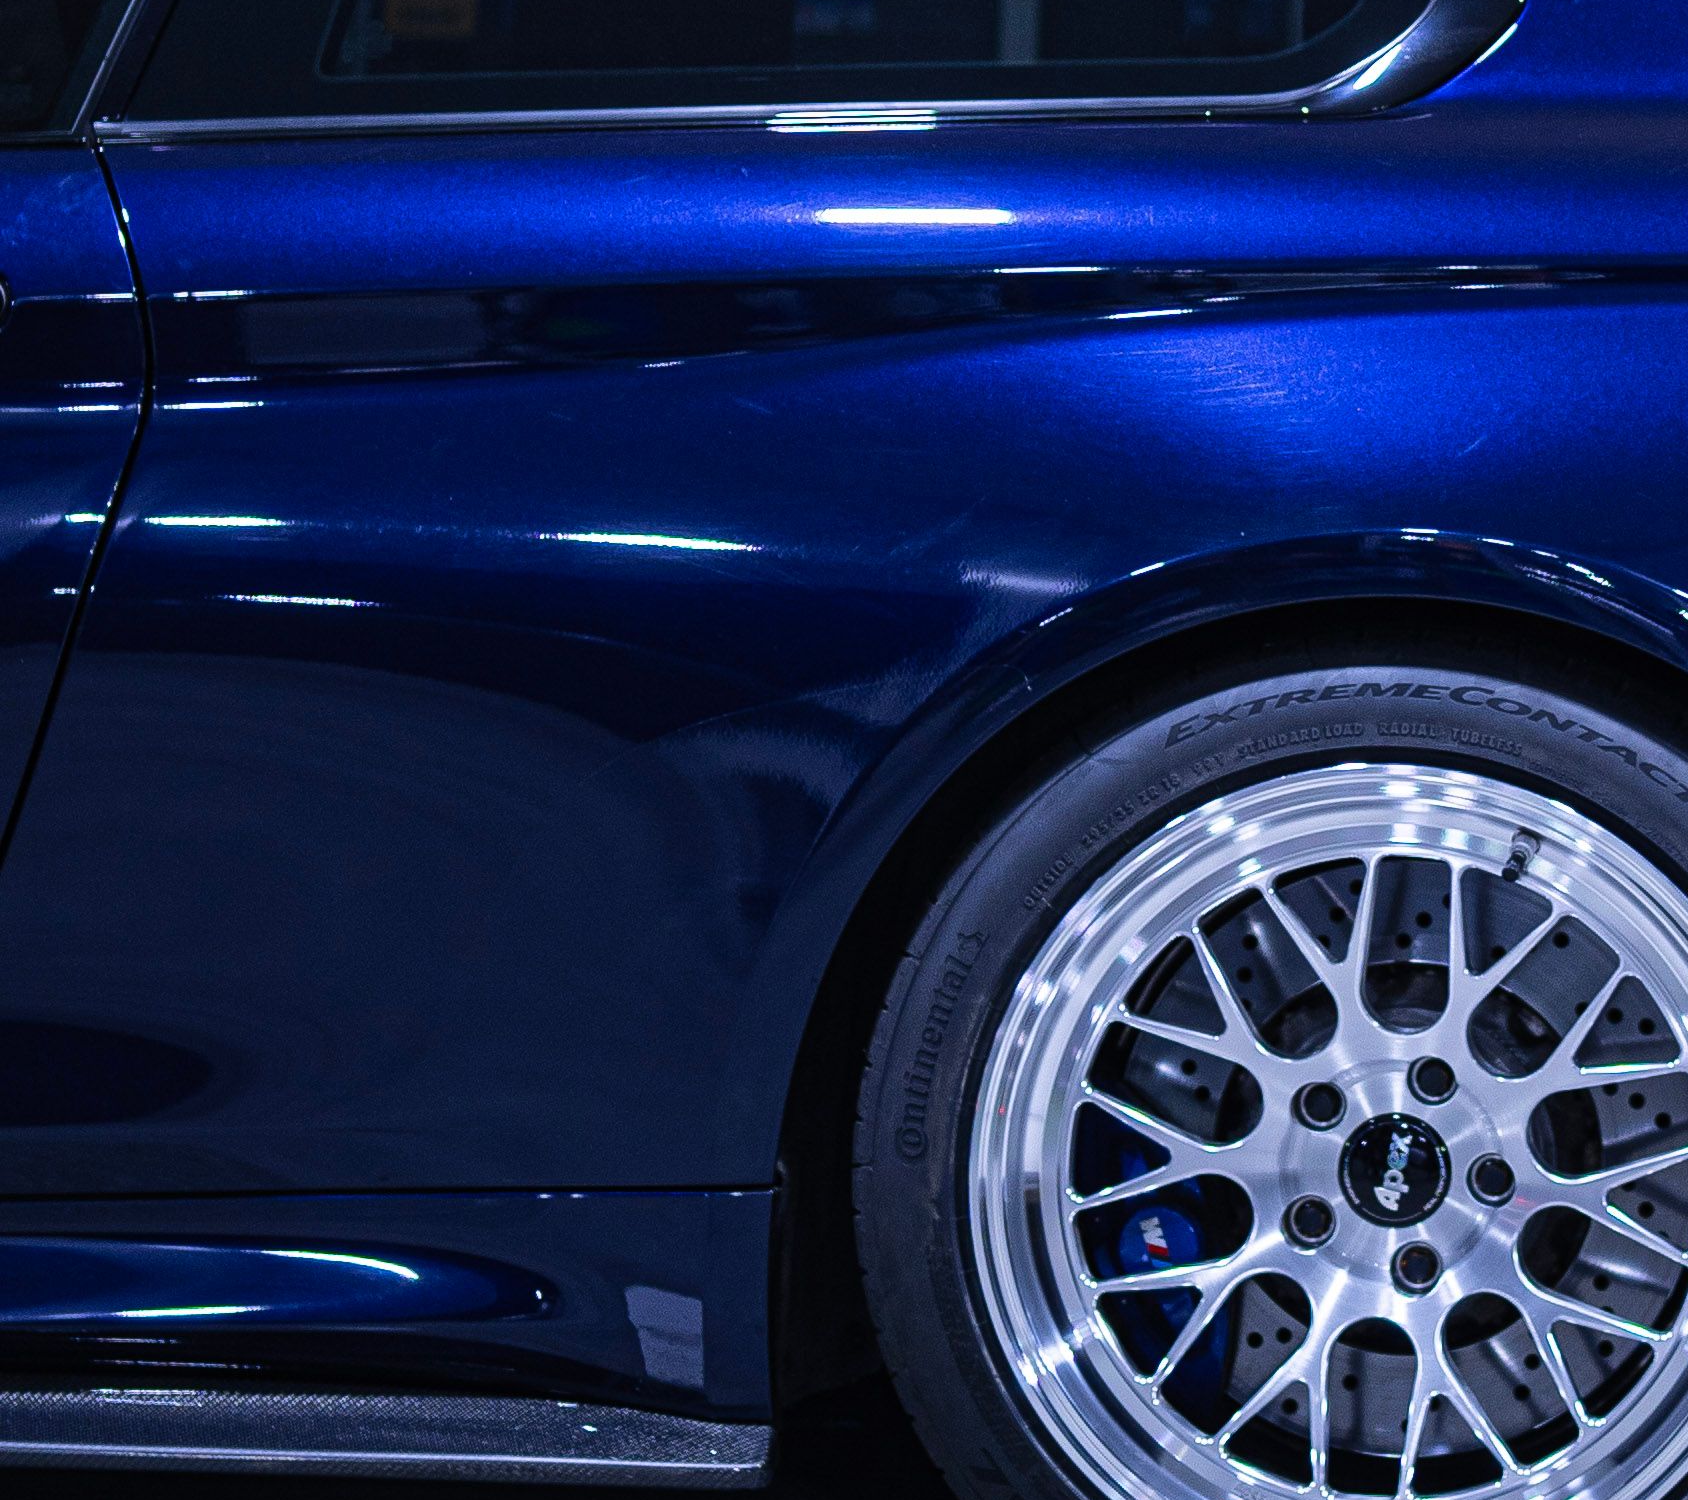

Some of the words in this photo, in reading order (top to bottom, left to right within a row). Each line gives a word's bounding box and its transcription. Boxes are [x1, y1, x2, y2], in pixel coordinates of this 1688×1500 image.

[1022, 852, 1074, 909] OUTSIDE
[1237, 728, 1320, 760] STANDARD
[1323, 722, 1363, 740] LOAD
[1377, 721, 1437, 738] RADIAL
[1450, 726, 1524, 756] TUBELESS
[897, 954, 973, 1164] Continental
